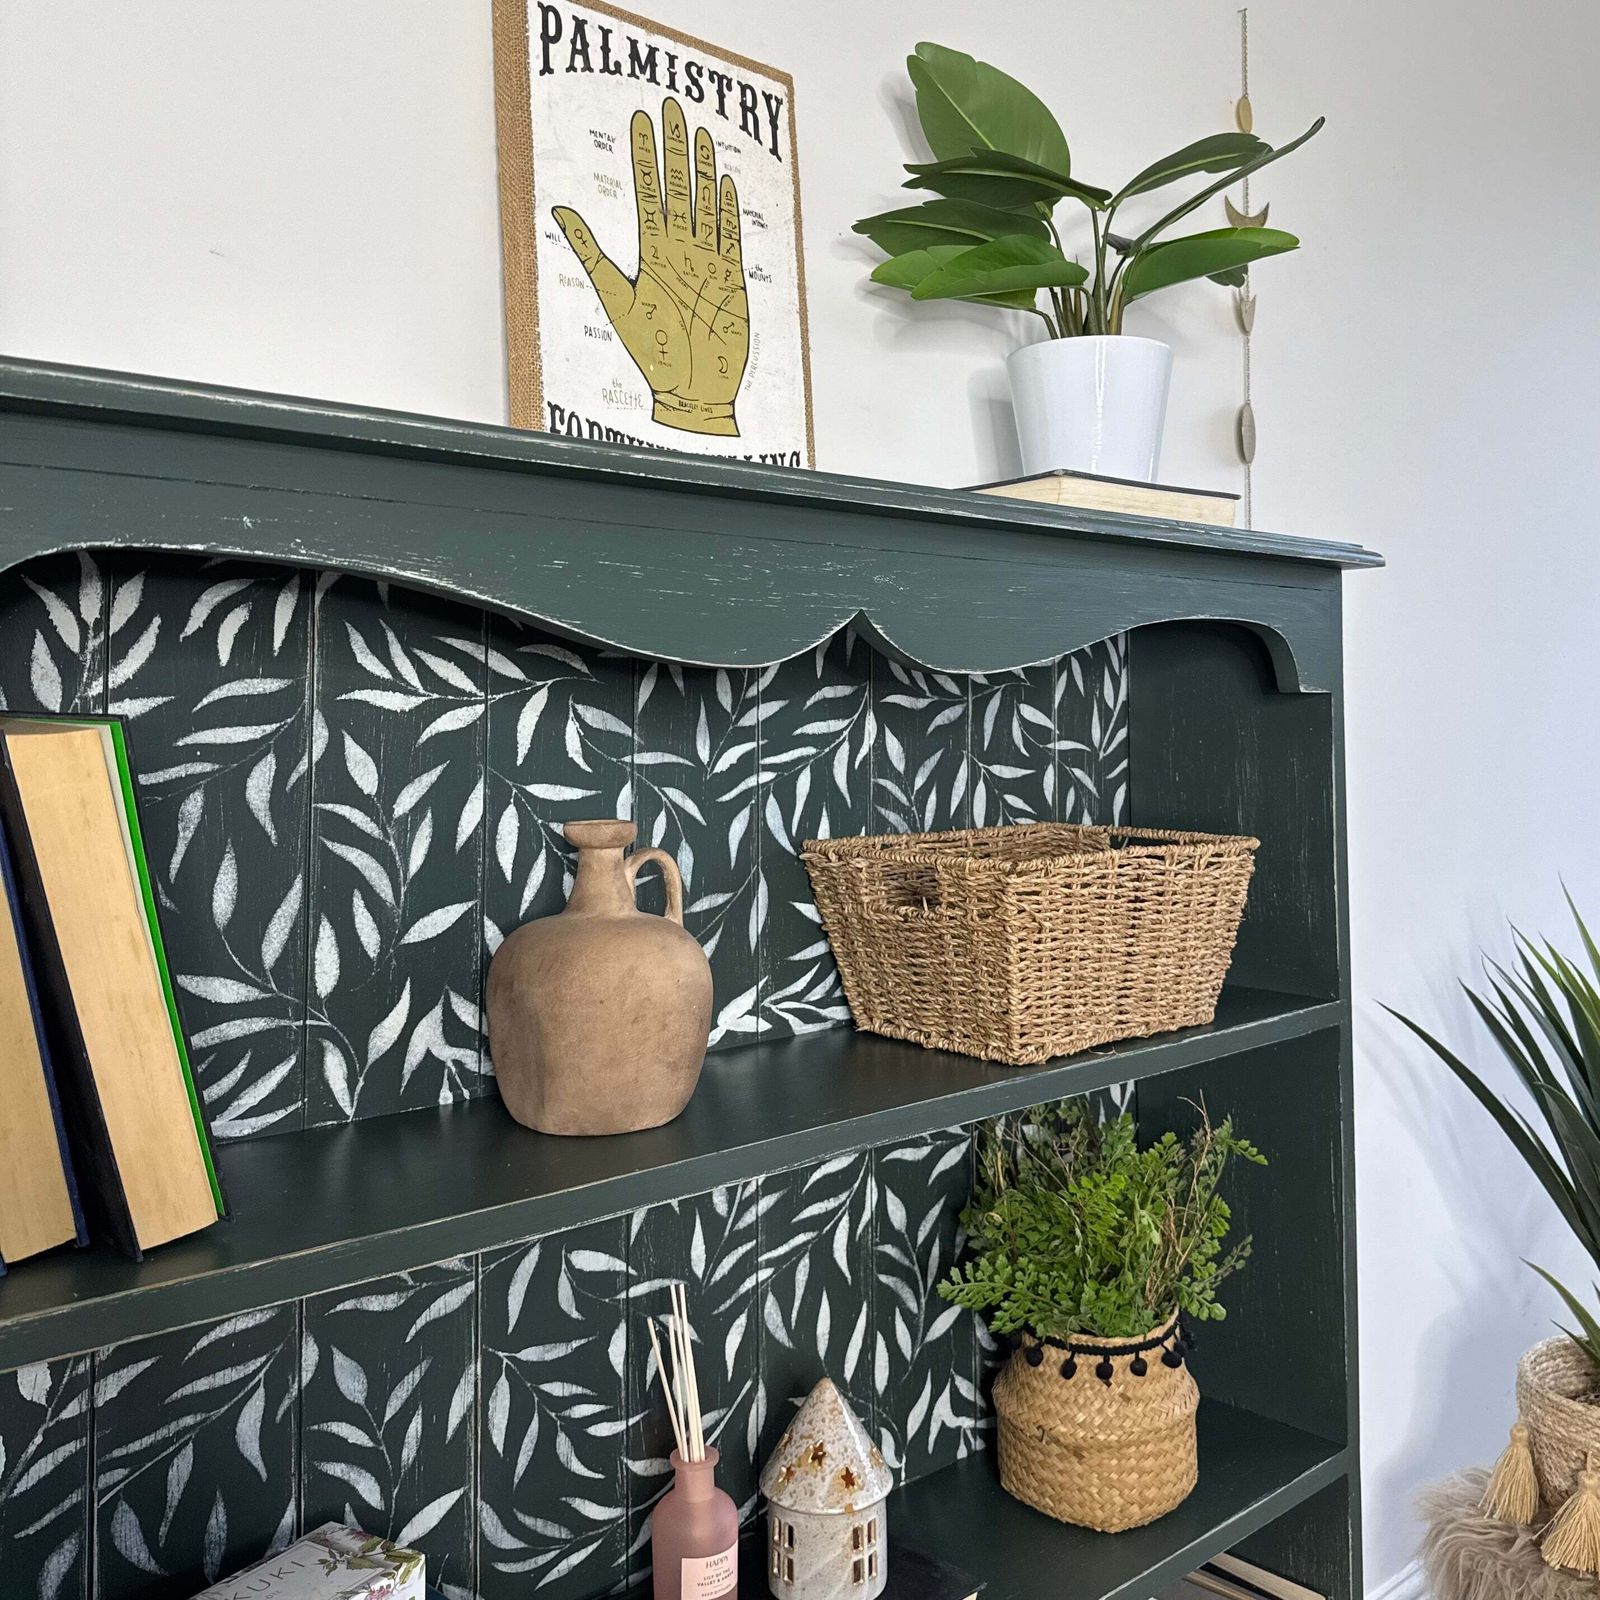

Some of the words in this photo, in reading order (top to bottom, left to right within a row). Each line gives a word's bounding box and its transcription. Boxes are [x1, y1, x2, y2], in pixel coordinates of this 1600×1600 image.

[537, 1, 784, 163] PALMISTRY
[594, 139, 613, 154] ORDER
[593, 172, 622, 190] MATERIAL
[598, 184, 617, 199] ORDER
[545, 231, 561, 242] WILL
[559, 273, 584, 289] REASON
[584, 325, 613, 342] PASSION
[749, 332, 761, 378] PERCUSSION
[612, 377, 622, 389] the
[705, 1555, 729, 1568] HAPPY
[696, 1579, 716, 1587] VALLEY
